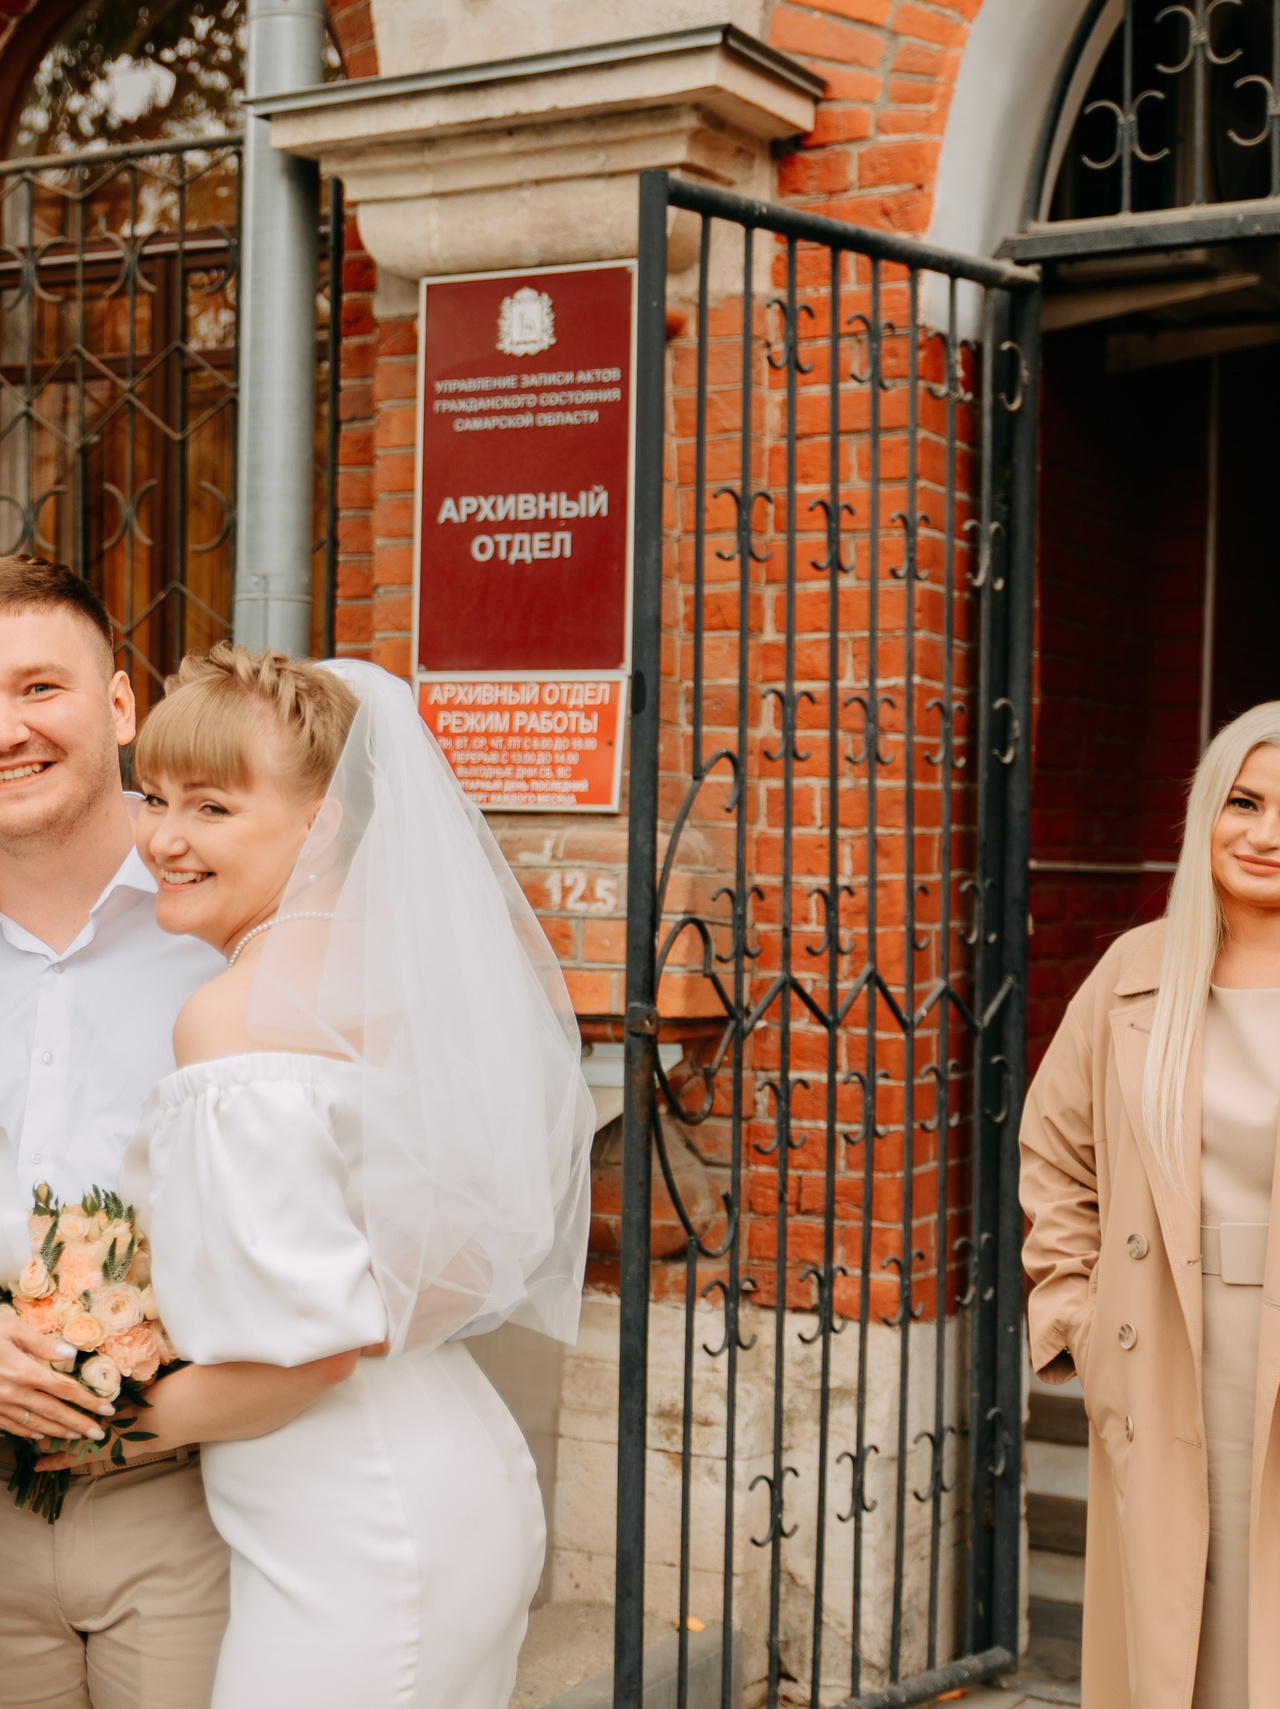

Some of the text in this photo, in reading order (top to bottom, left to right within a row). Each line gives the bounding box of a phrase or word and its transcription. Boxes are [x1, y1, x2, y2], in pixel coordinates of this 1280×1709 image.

[434, 367, 621, 394] УПРАВЛЕНИЕ ЗАПИСИ АКТОВ
[433, 388, 621, 413] ГРАЖДАНСКОГО СОСТОЯНИЯ
[453, 410, 599, 432] САМАРСКОЙ ОБЛАСТИ
[437, 484, 608, 524] АРХИВНЫЙ
[471, 531, 572, 565] ОТДЕЛ
[429, 681, 610, 708] АРХИВНЫЙ ОТДЕЛ
[437, 711, 598, 733] РЕЖИМ РАБОТЫ
[553, 737, 570, 751] ДО
[451, 750, 500, 764] ПЕРЕРЫВ
[500, 750, 510, 764] С
[536, 751, 553, 766] ДО
[456, 765, 514, 779] ВЫХОДНЫЕ
[515, 765, 537, 779] ДНИ
[530, 778, 589, 793] ПОСЛЕДНИЙ
